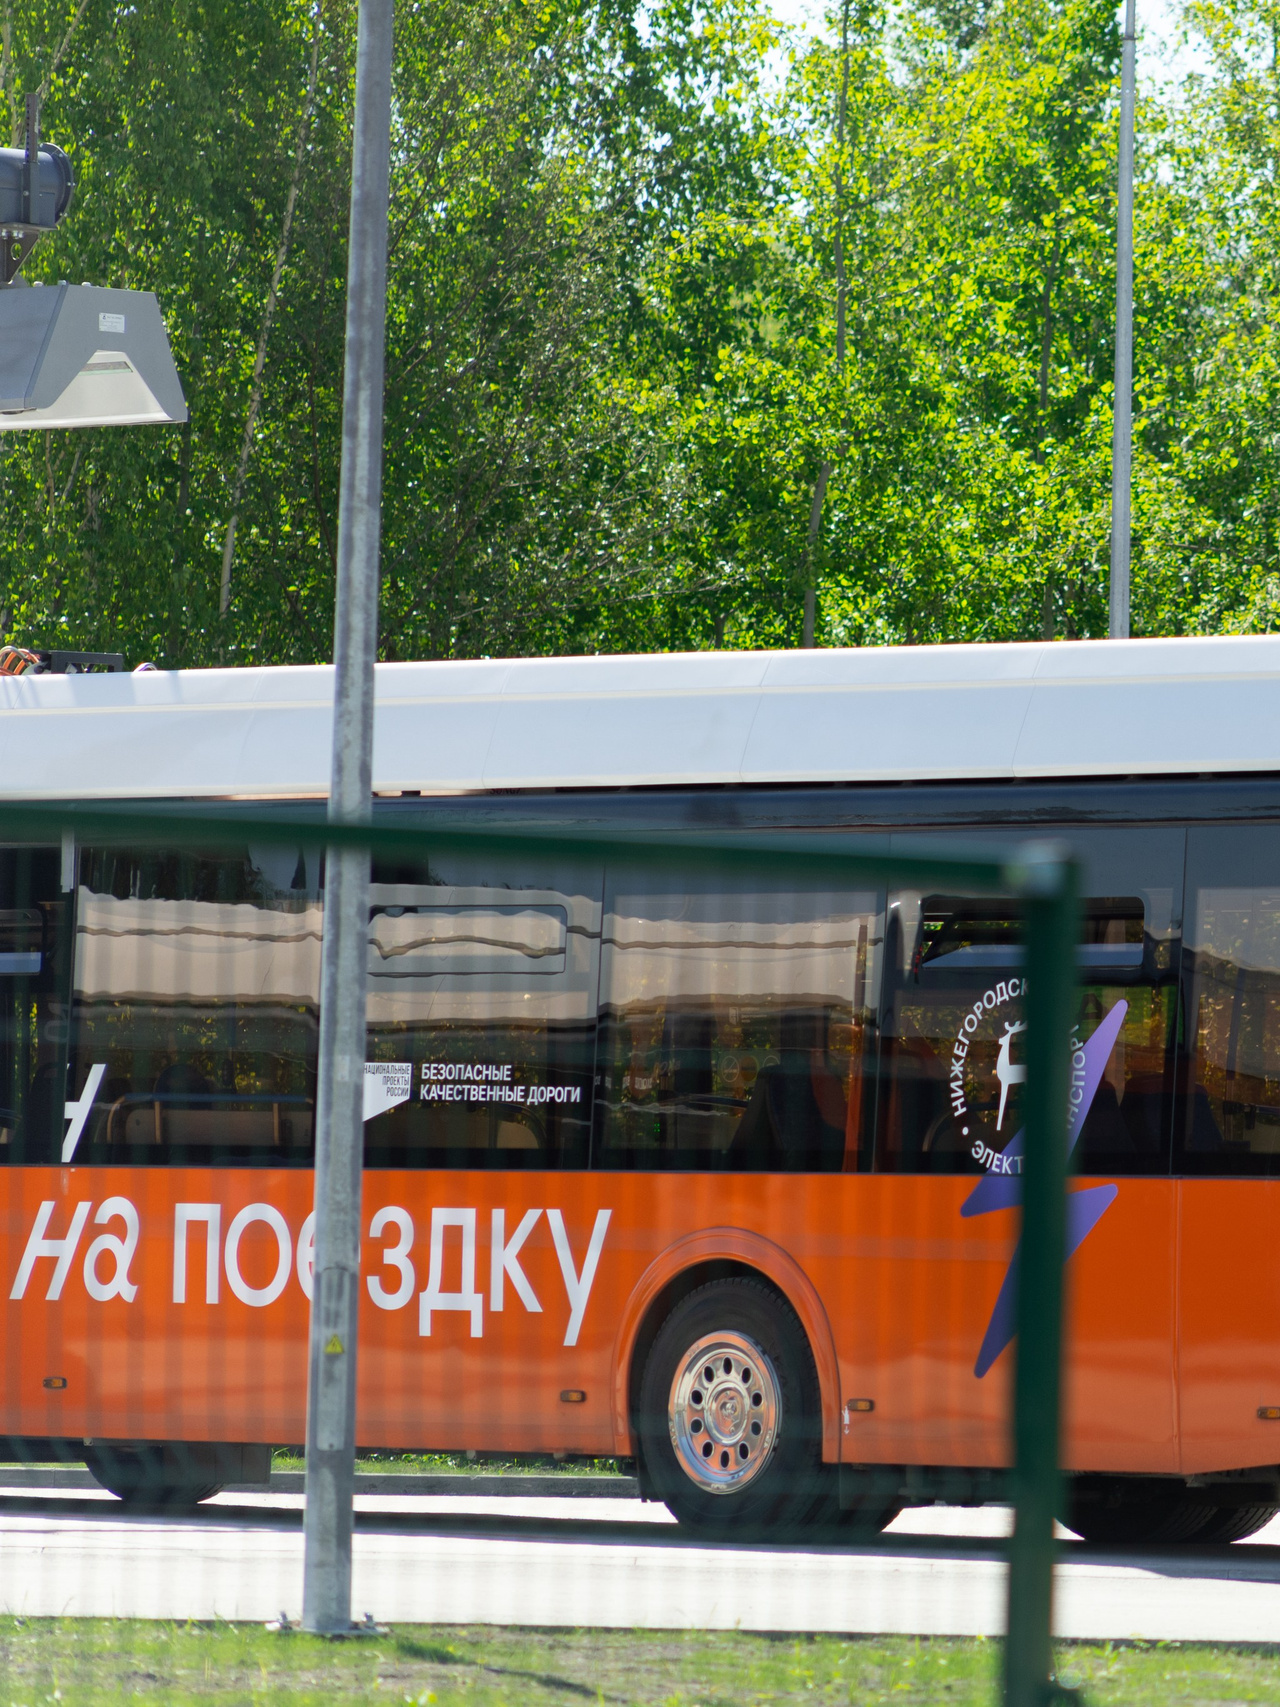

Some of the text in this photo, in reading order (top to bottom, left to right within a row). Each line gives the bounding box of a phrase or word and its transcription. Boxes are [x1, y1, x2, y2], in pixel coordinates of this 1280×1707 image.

[949, 977, 1030, 1118] НИЖЕГОРОДСК
[364, 1064, 410, 1075] НАЦИОНАЛЬНЫЕ
[421, 1063, 512, 1082] БЕЗОПАСНЫЕ
[382, 1075, 410, 1086] ПРОЕКТЫ
[386, 1086, 409, 1097] РОССИИ
[420, 1084, 581, 1105] КАЧЕСТВЕННЫЕ ДОРОГИ
